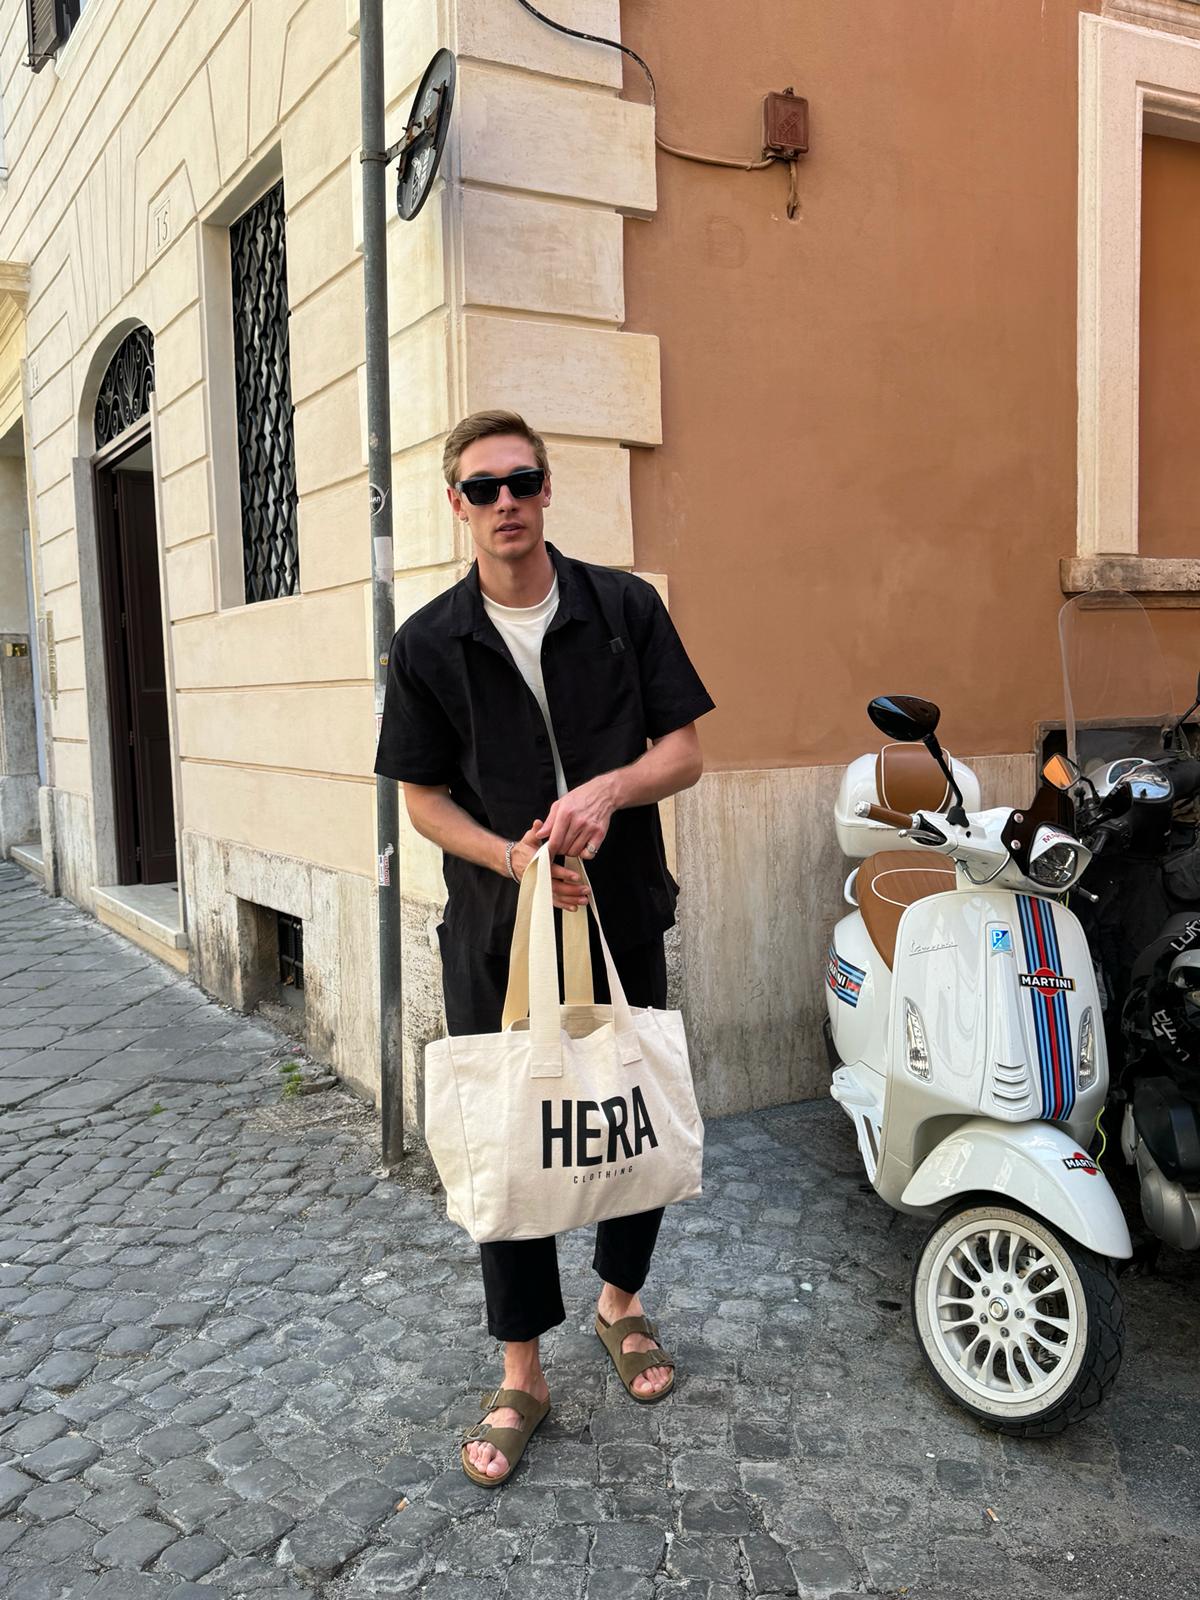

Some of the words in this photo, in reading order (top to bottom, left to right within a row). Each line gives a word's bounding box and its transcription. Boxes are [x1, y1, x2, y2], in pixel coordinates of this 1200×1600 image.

[992, 930, 1003, 944] P
[1021, 975, 1072, 989] MARTINI
[542, 1085, 659, 1169] HERA
[573, 1165, 633, 1184] CLOTHING
